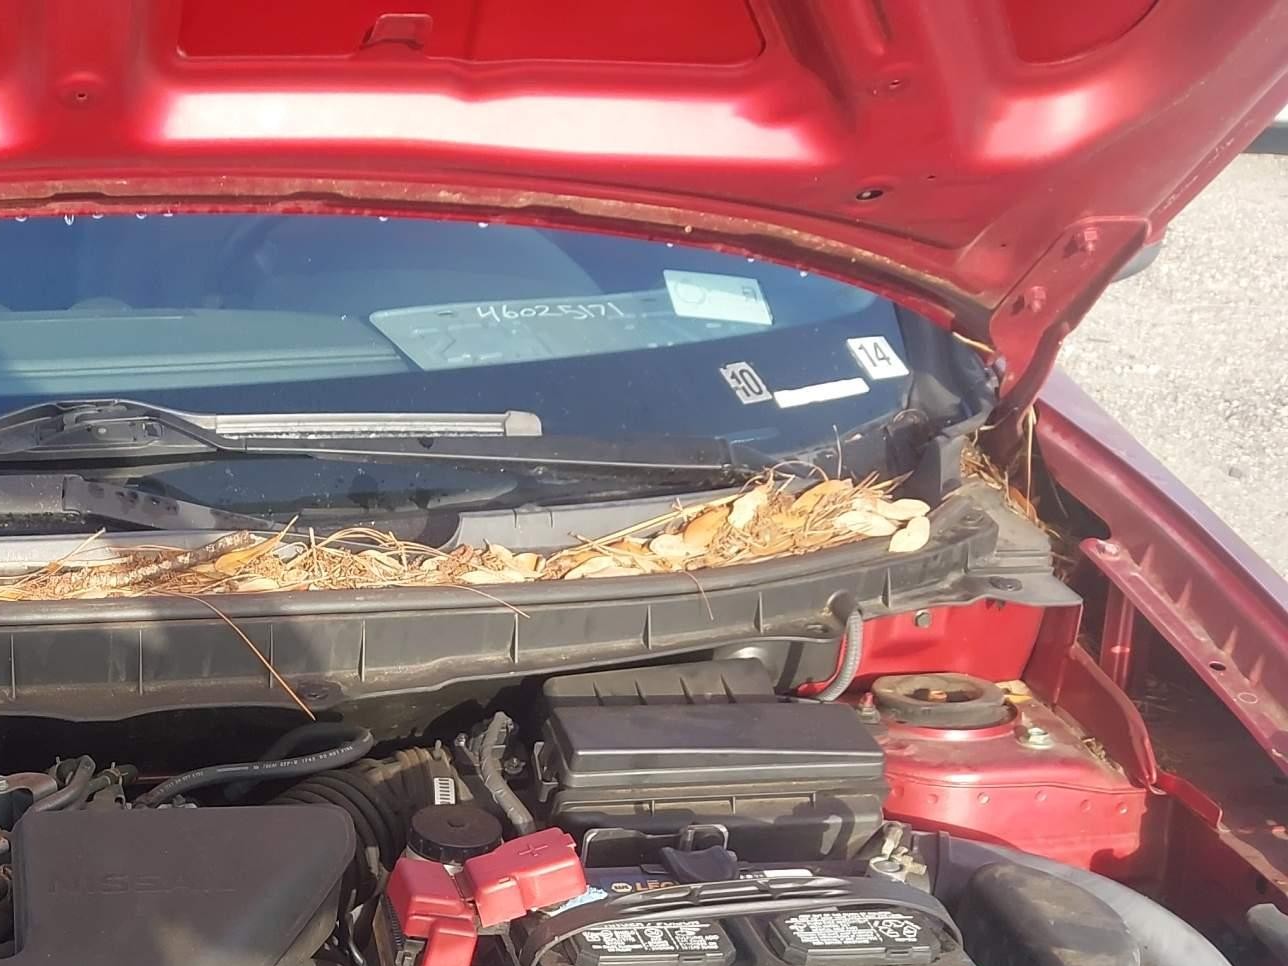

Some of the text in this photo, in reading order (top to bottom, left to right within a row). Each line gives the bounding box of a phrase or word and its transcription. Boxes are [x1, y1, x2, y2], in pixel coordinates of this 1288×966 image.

[476, 302, 625, 323] 46025171
[857, 341, 892, 368] 14
[729, 368, 764, 398] 10
